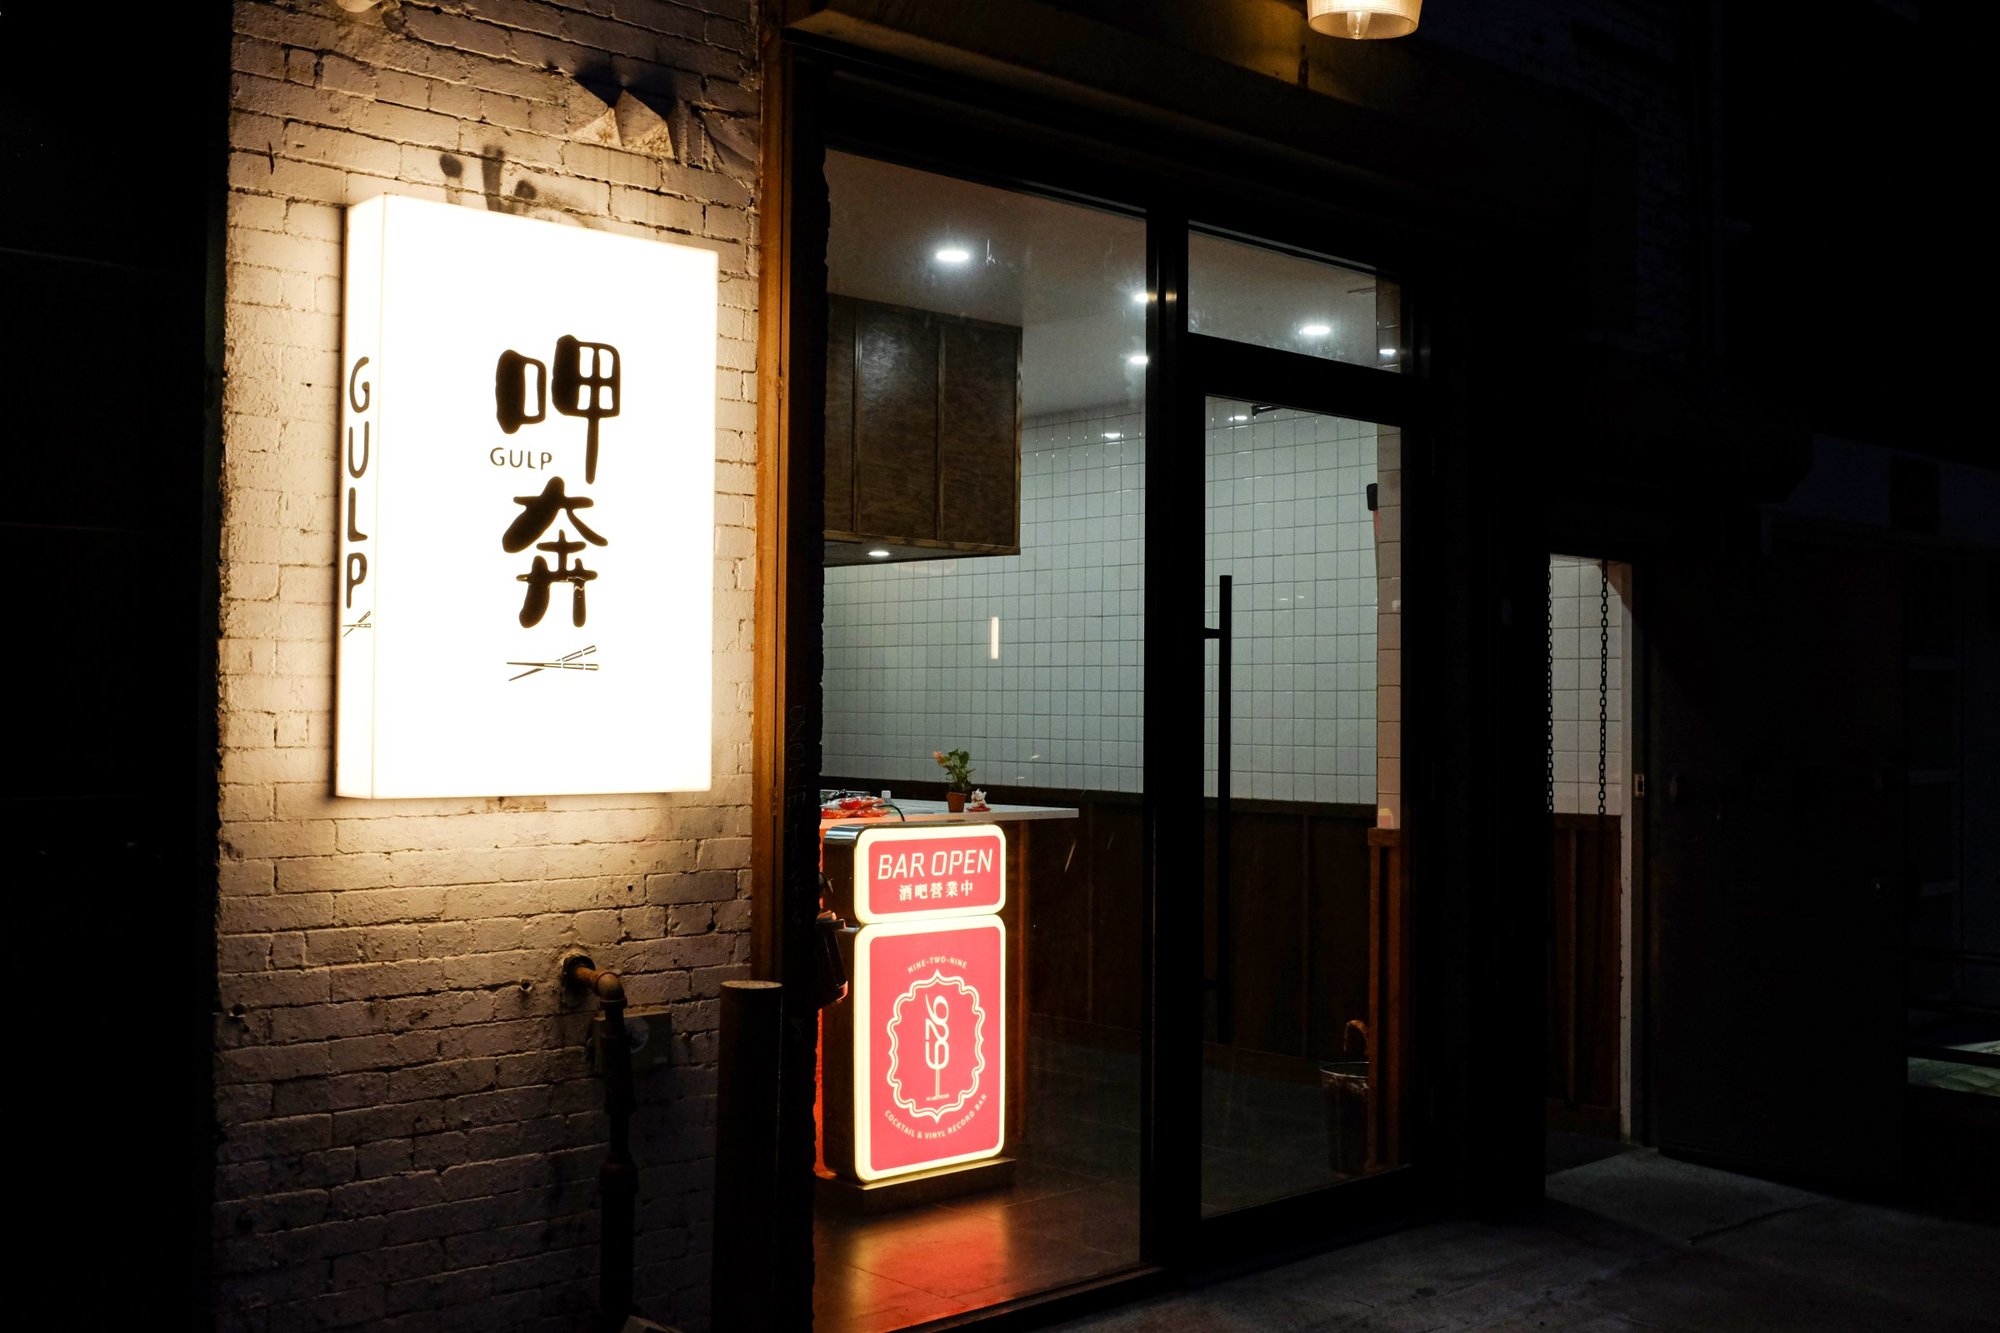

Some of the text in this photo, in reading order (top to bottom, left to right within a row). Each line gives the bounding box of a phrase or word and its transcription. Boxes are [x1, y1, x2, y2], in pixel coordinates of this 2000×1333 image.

[489, 446, 553, 471] GULP
[346, 356, 371, 609] GULP
[877, 848, 993, 880] BAR OPEN
[898, 879, 974, 901] 酒吧營業中
[907, 956, 968, 974] NINE-TWO-NINE
[884, 1093, 988, 1140] COCKTAIL & VINYL RECORD BAR
